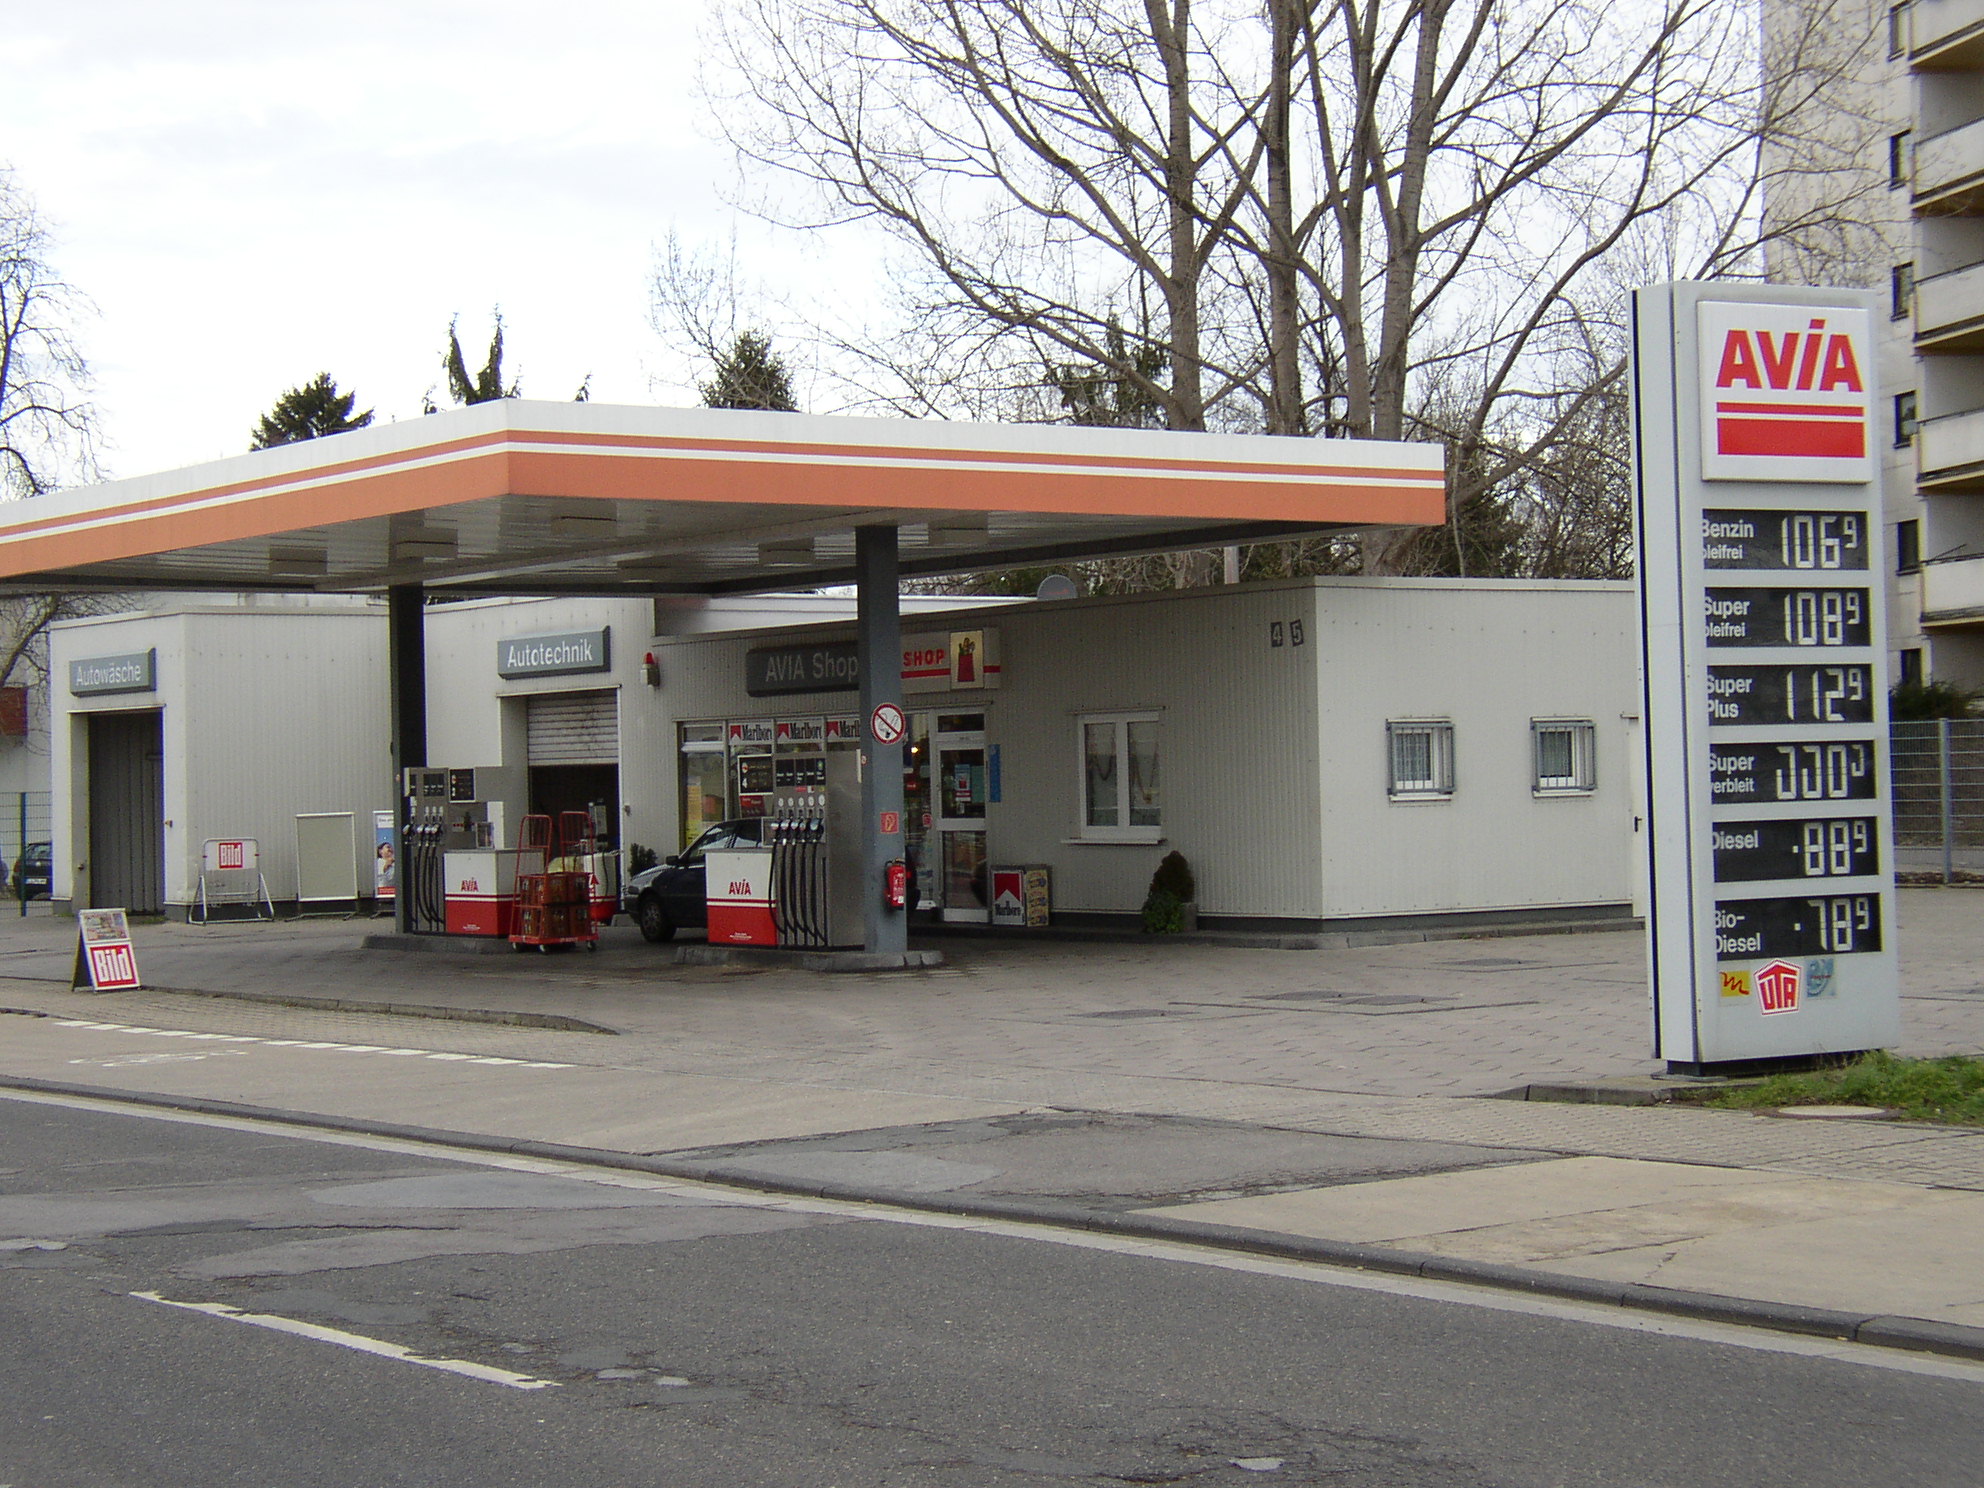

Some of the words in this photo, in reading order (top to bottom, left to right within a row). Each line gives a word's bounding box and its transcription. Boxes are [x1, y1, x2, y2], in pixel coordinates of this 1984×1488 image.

[1716, 318, 1864, 393] AVIA
[1700, 518, 1755, 538] Benzin
[1704, 595, 1751, 620] Super
[507, 638, 593, 668] Autotechnik
[903, 648, 945, 667] SHOP
[75, 660, 141, 685] Autowäsche
[765, 653, 805, 682] AVIA
[812, 651, 858, 682] Shop
[1707, 674, 1753, 698] Super
[1707, 699, 1739, 718] Plus
[1709, 753, 1755, 775] Super
[1712, 829, 1759, 850] Diesel
[220, 844, 242, 866] Bild
[461, 877, 479, 893] AVIA
[728, 879, 752, 896] AVIA
[1715, 932, 1761, 953] Diesel
[94, 947, 133, 983] Bild
[1758, 964, 1798, 1010] UTA
